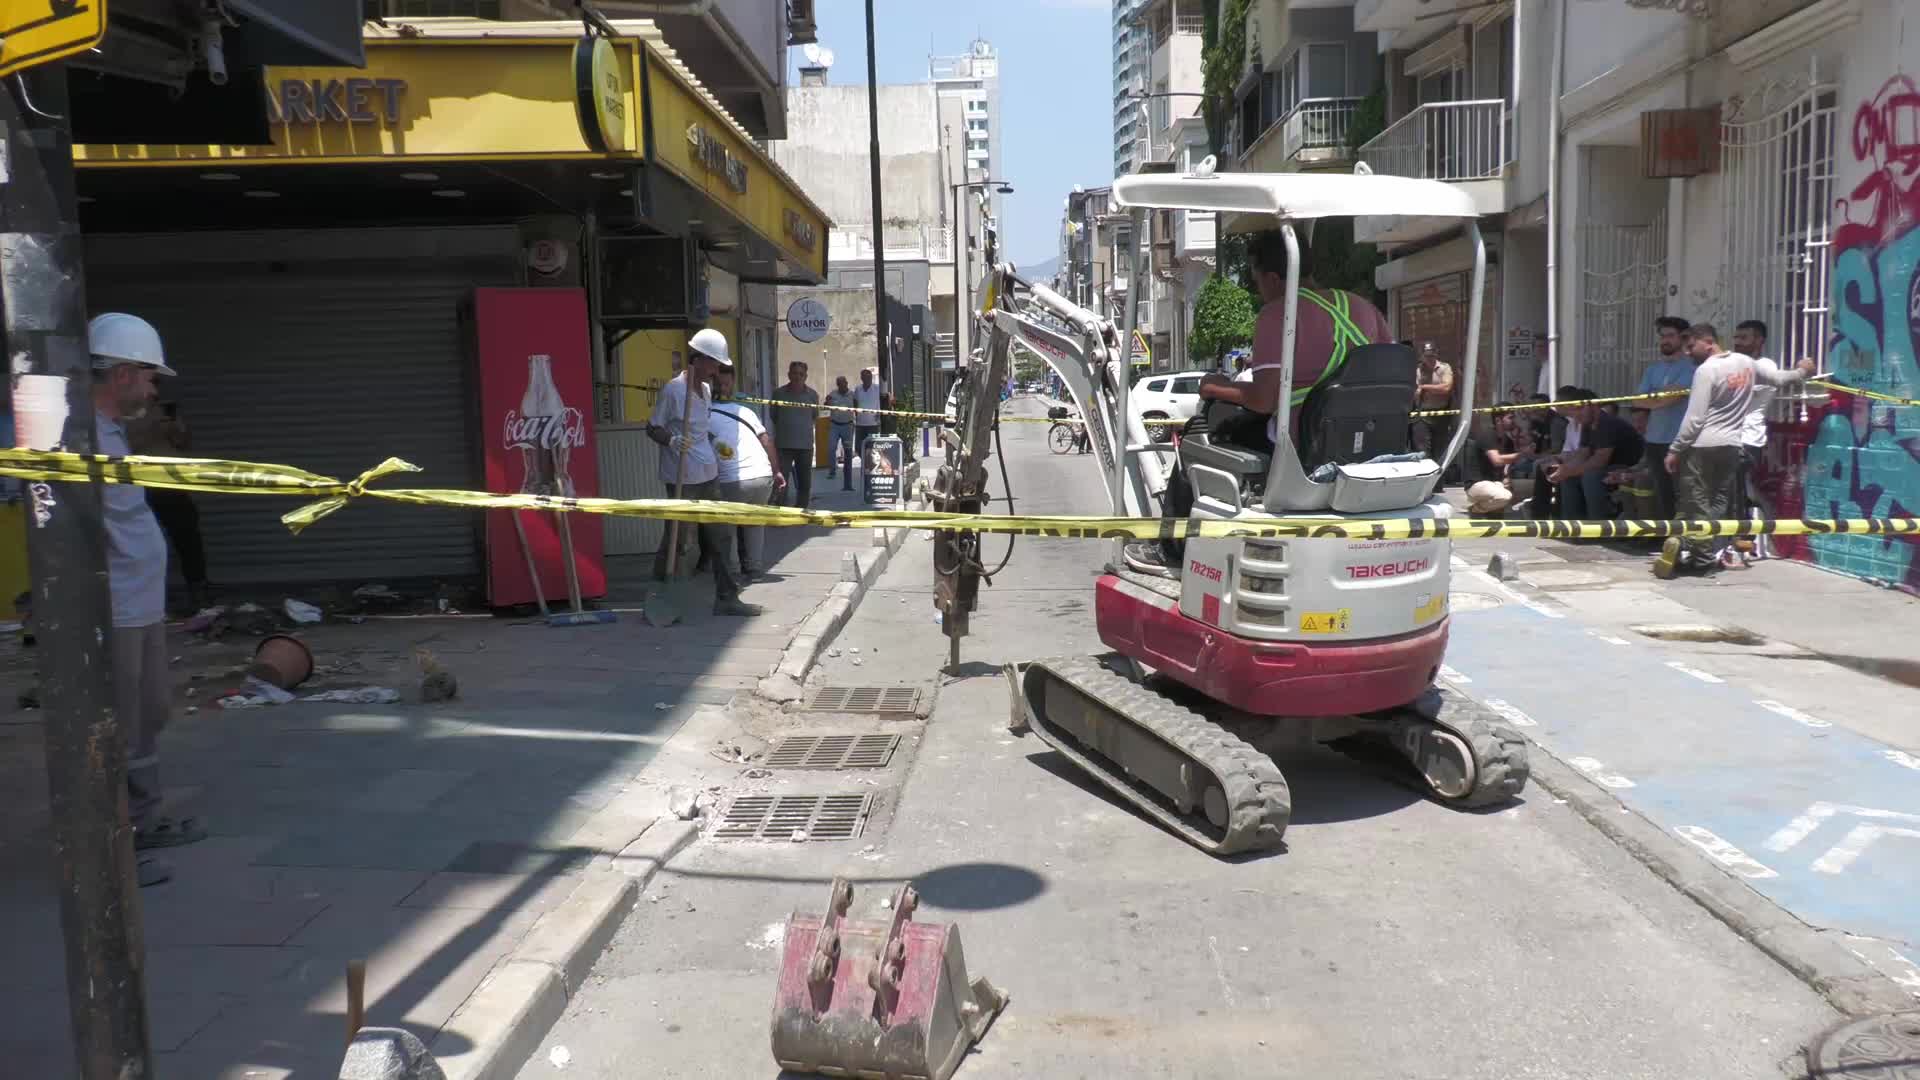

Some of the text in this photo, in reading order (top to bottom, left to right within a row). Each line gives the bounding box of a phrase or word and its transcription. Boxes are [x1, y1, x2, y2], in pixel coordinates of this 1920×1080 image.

[503, 407, 585, 450] Coca-Cola
[1190, 559, 1223, 582] TB215R
[1346, 558, 1429, 579] TAKEUCHI
